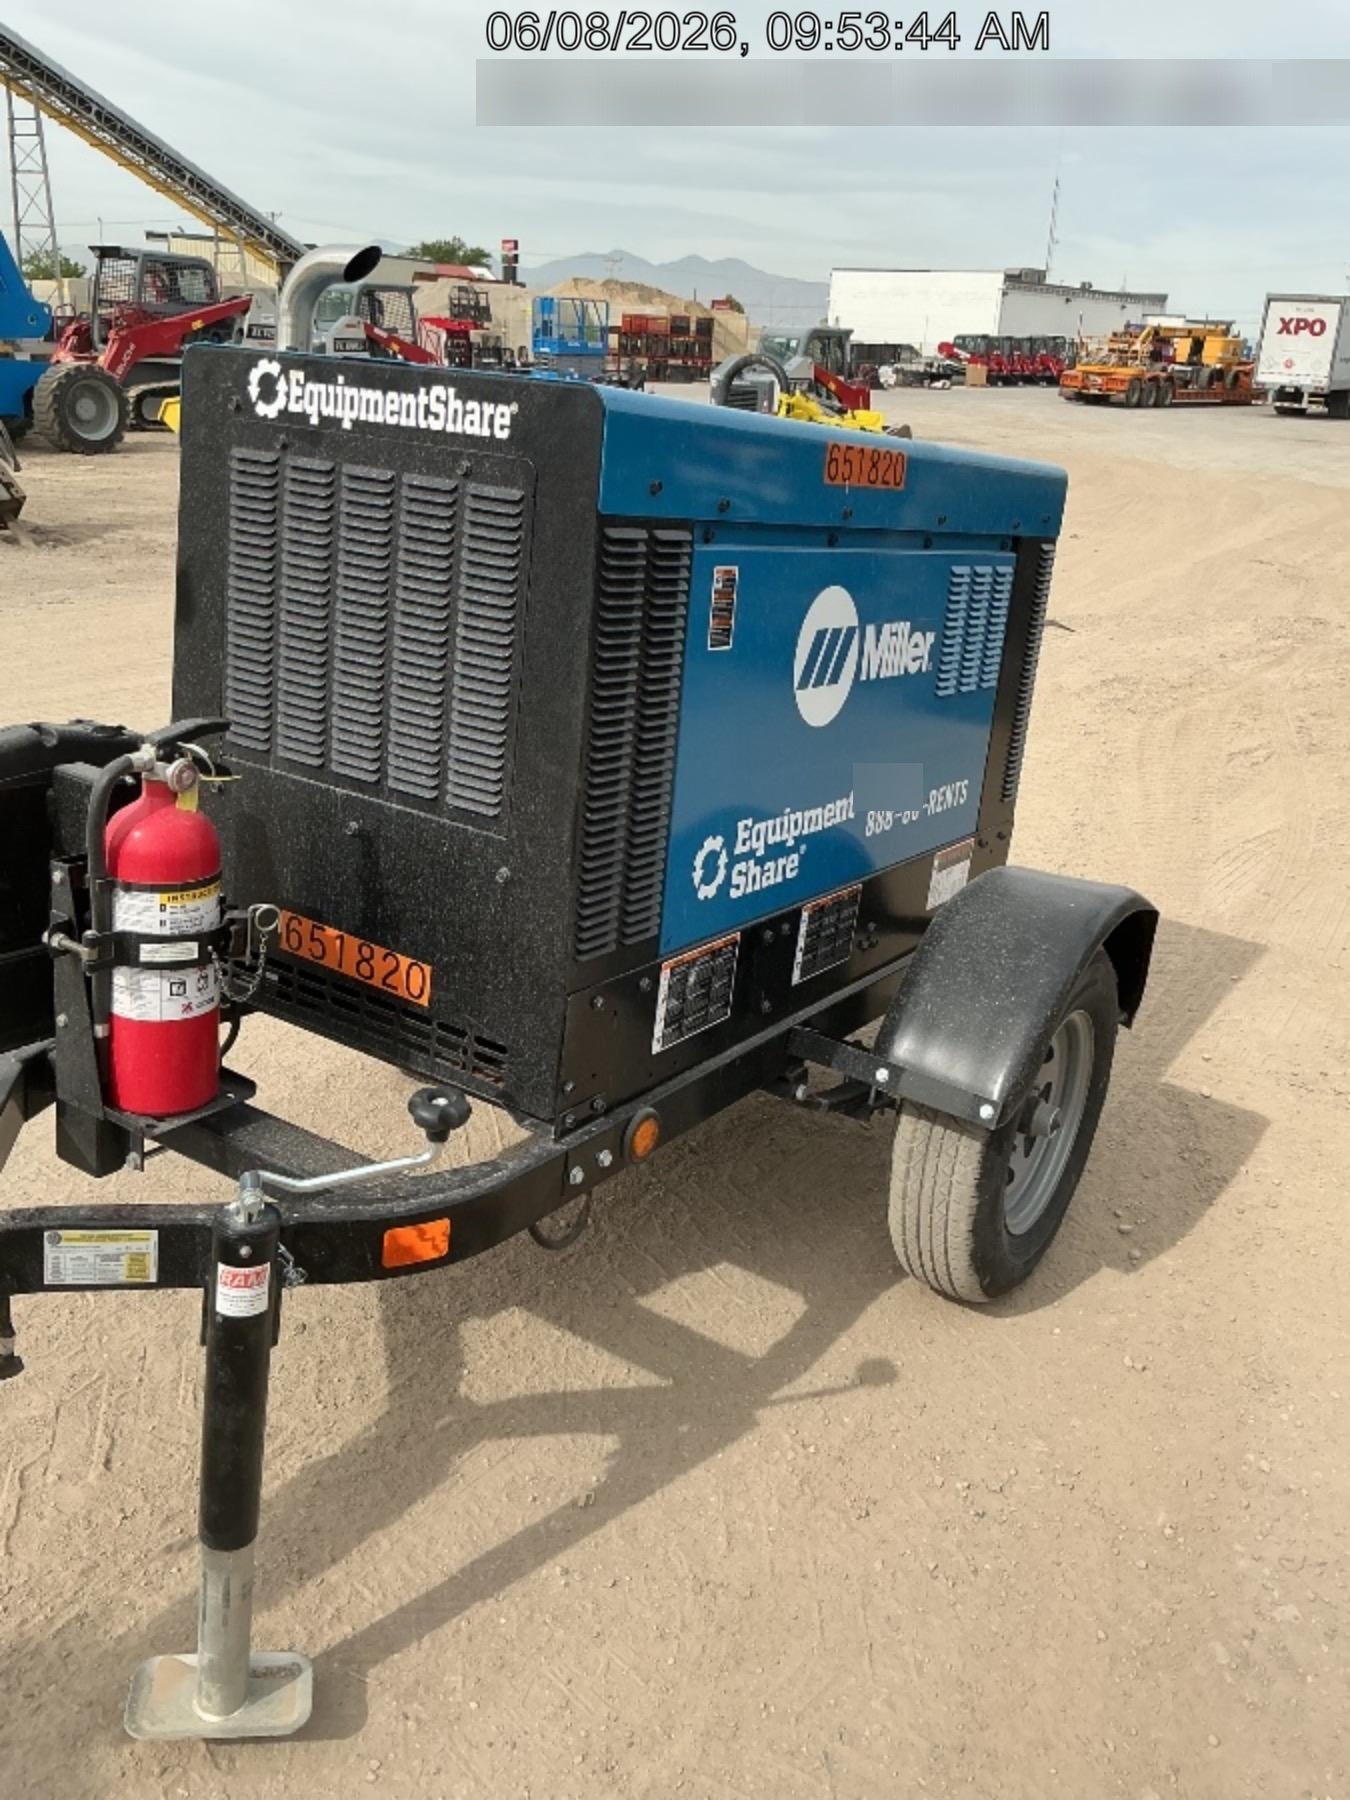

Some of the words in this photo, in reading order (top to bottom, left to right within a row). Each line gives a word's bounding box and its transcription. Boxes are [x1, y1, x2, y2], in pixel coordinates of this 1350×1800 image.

[1276, 317, 1327, 337] XPO
[827, 443, 905, 487] 651820
[860, 621, 936, 681] Miller
[733, 790, 854, 857] Equipment
[285, 915, 426, 1000] 651820
